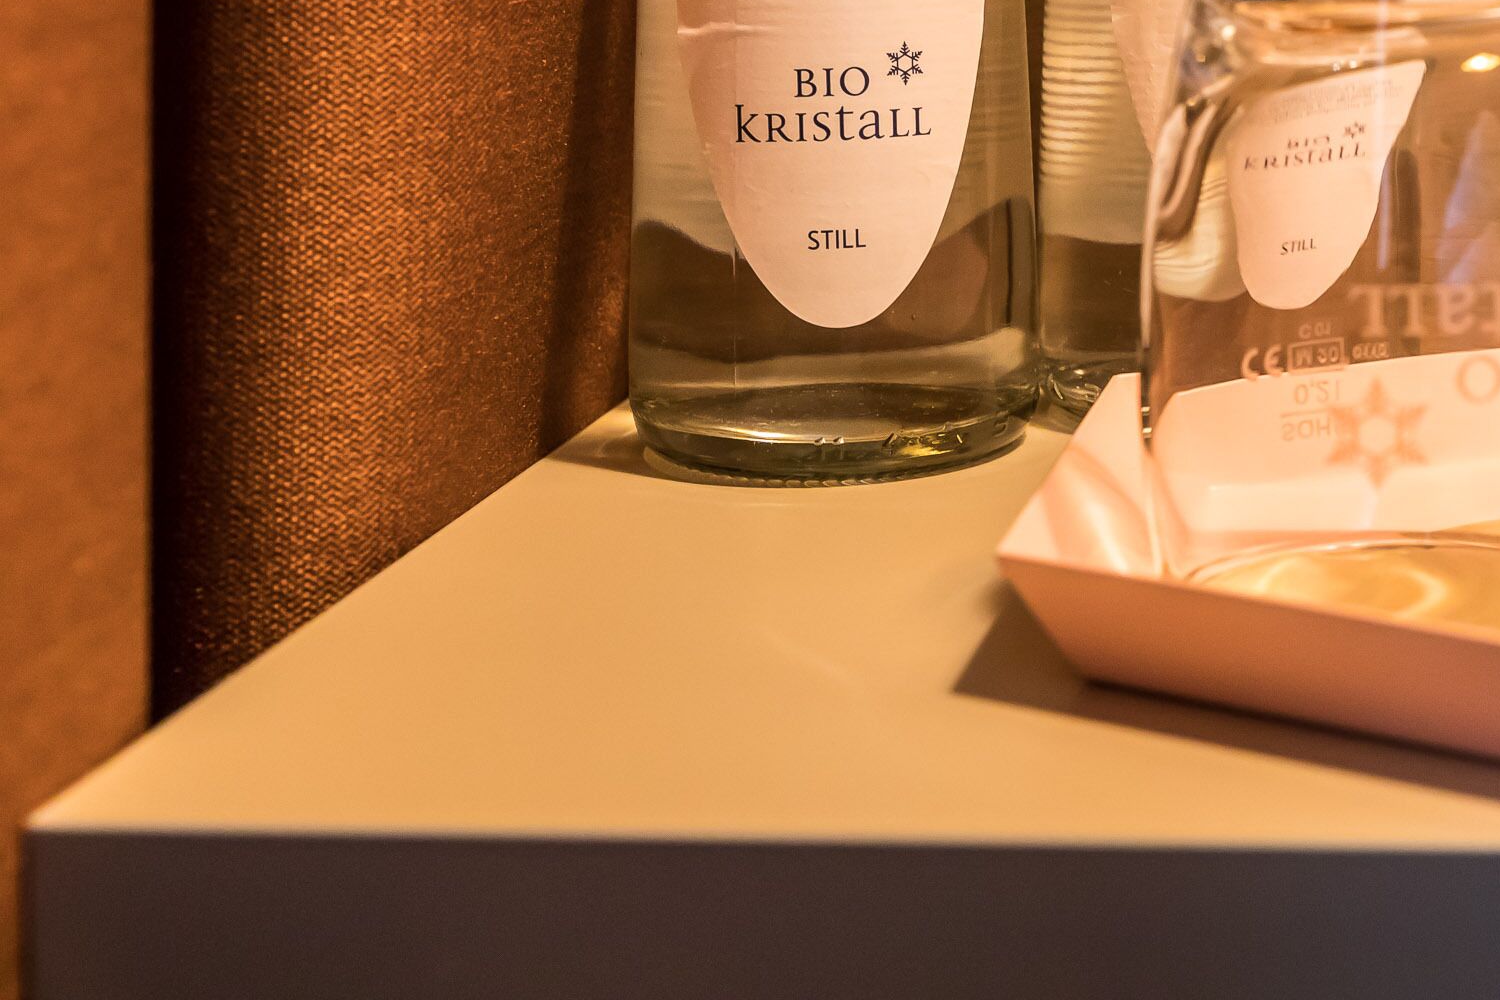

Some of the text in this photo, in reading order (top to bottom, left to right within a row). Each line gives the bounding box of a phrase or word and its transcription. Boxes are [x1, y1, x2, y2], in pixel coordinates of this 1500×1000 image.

[793, 66, 870, 98] BIO
[808, 229, 866, 250] STILL
[1280, 238, 1317, 256] STILL
